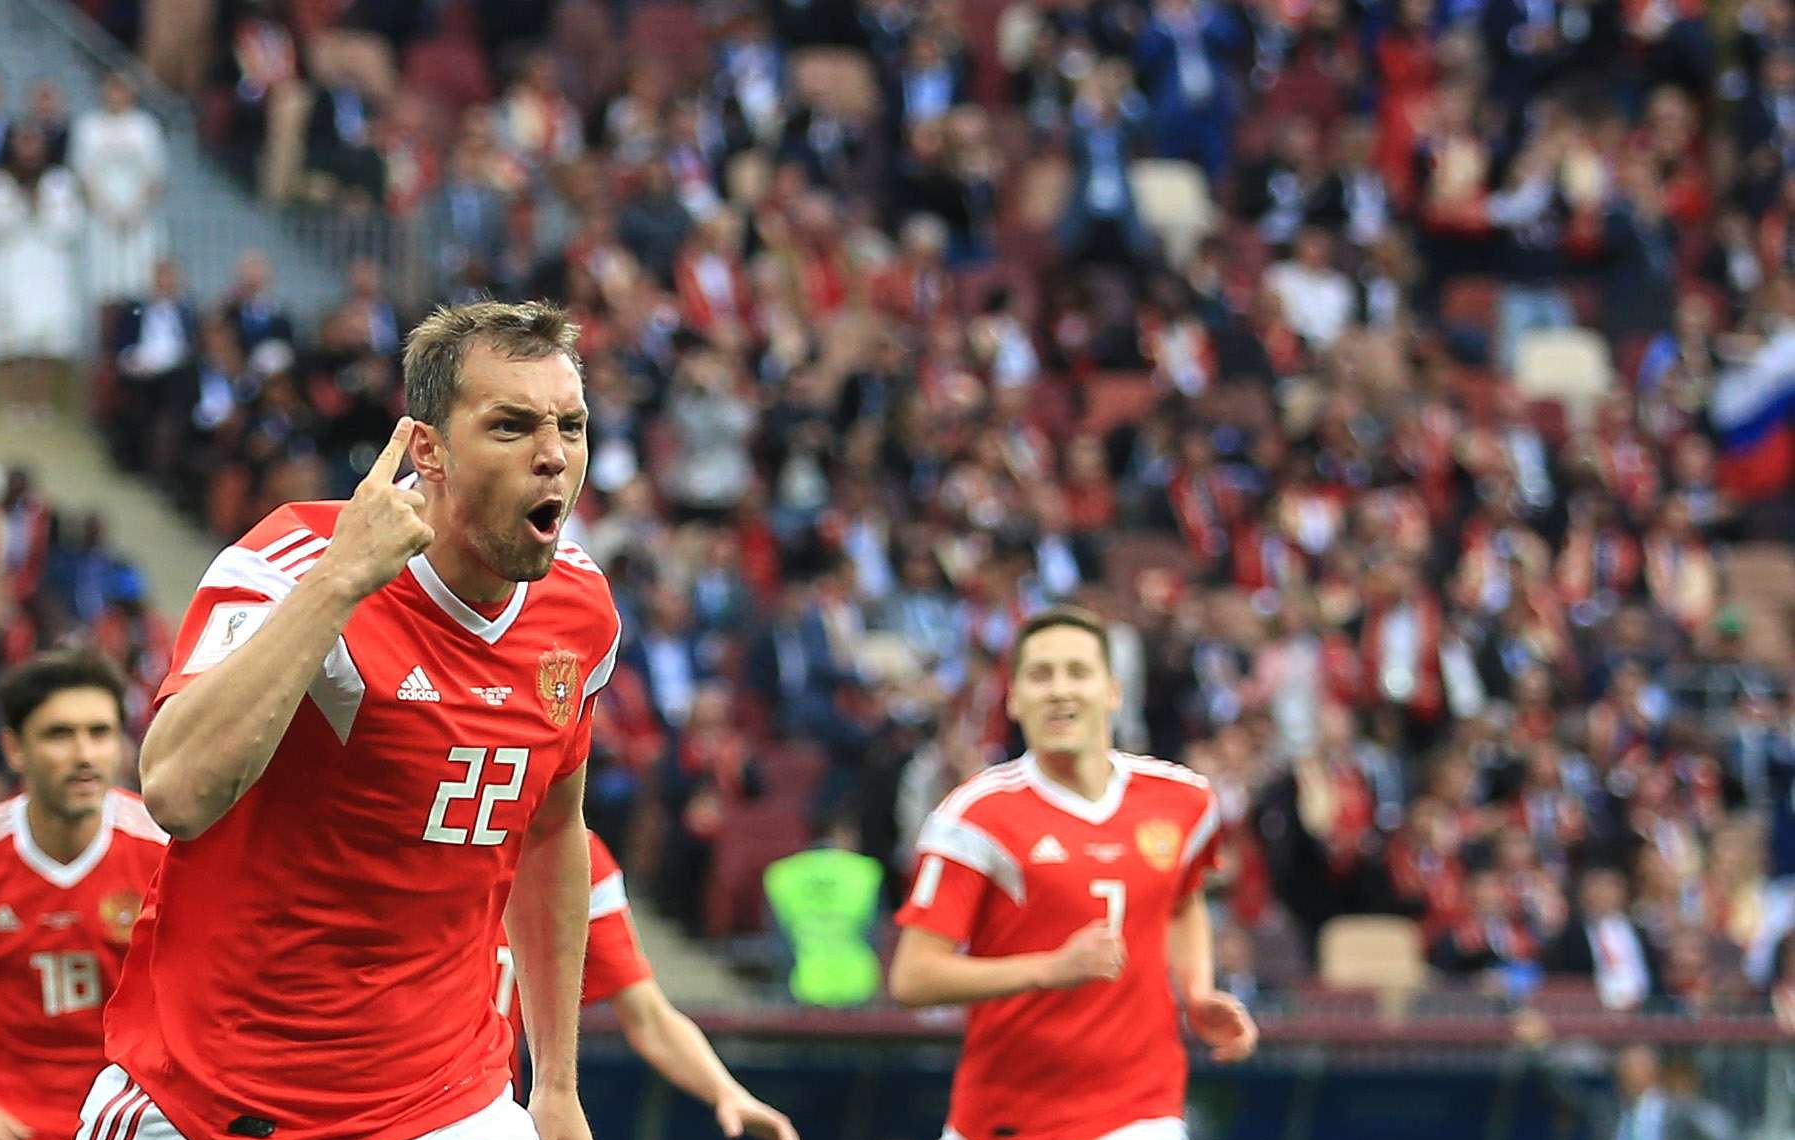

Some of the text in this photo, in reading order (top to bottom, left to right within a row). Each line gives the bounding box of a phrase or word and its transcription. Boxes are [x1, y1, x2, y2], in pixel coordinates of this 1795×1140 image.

[397, 689, 441, 703] adidas
[422, 746, 530, 846] 22
[29, 951, 102, 1017] 18
